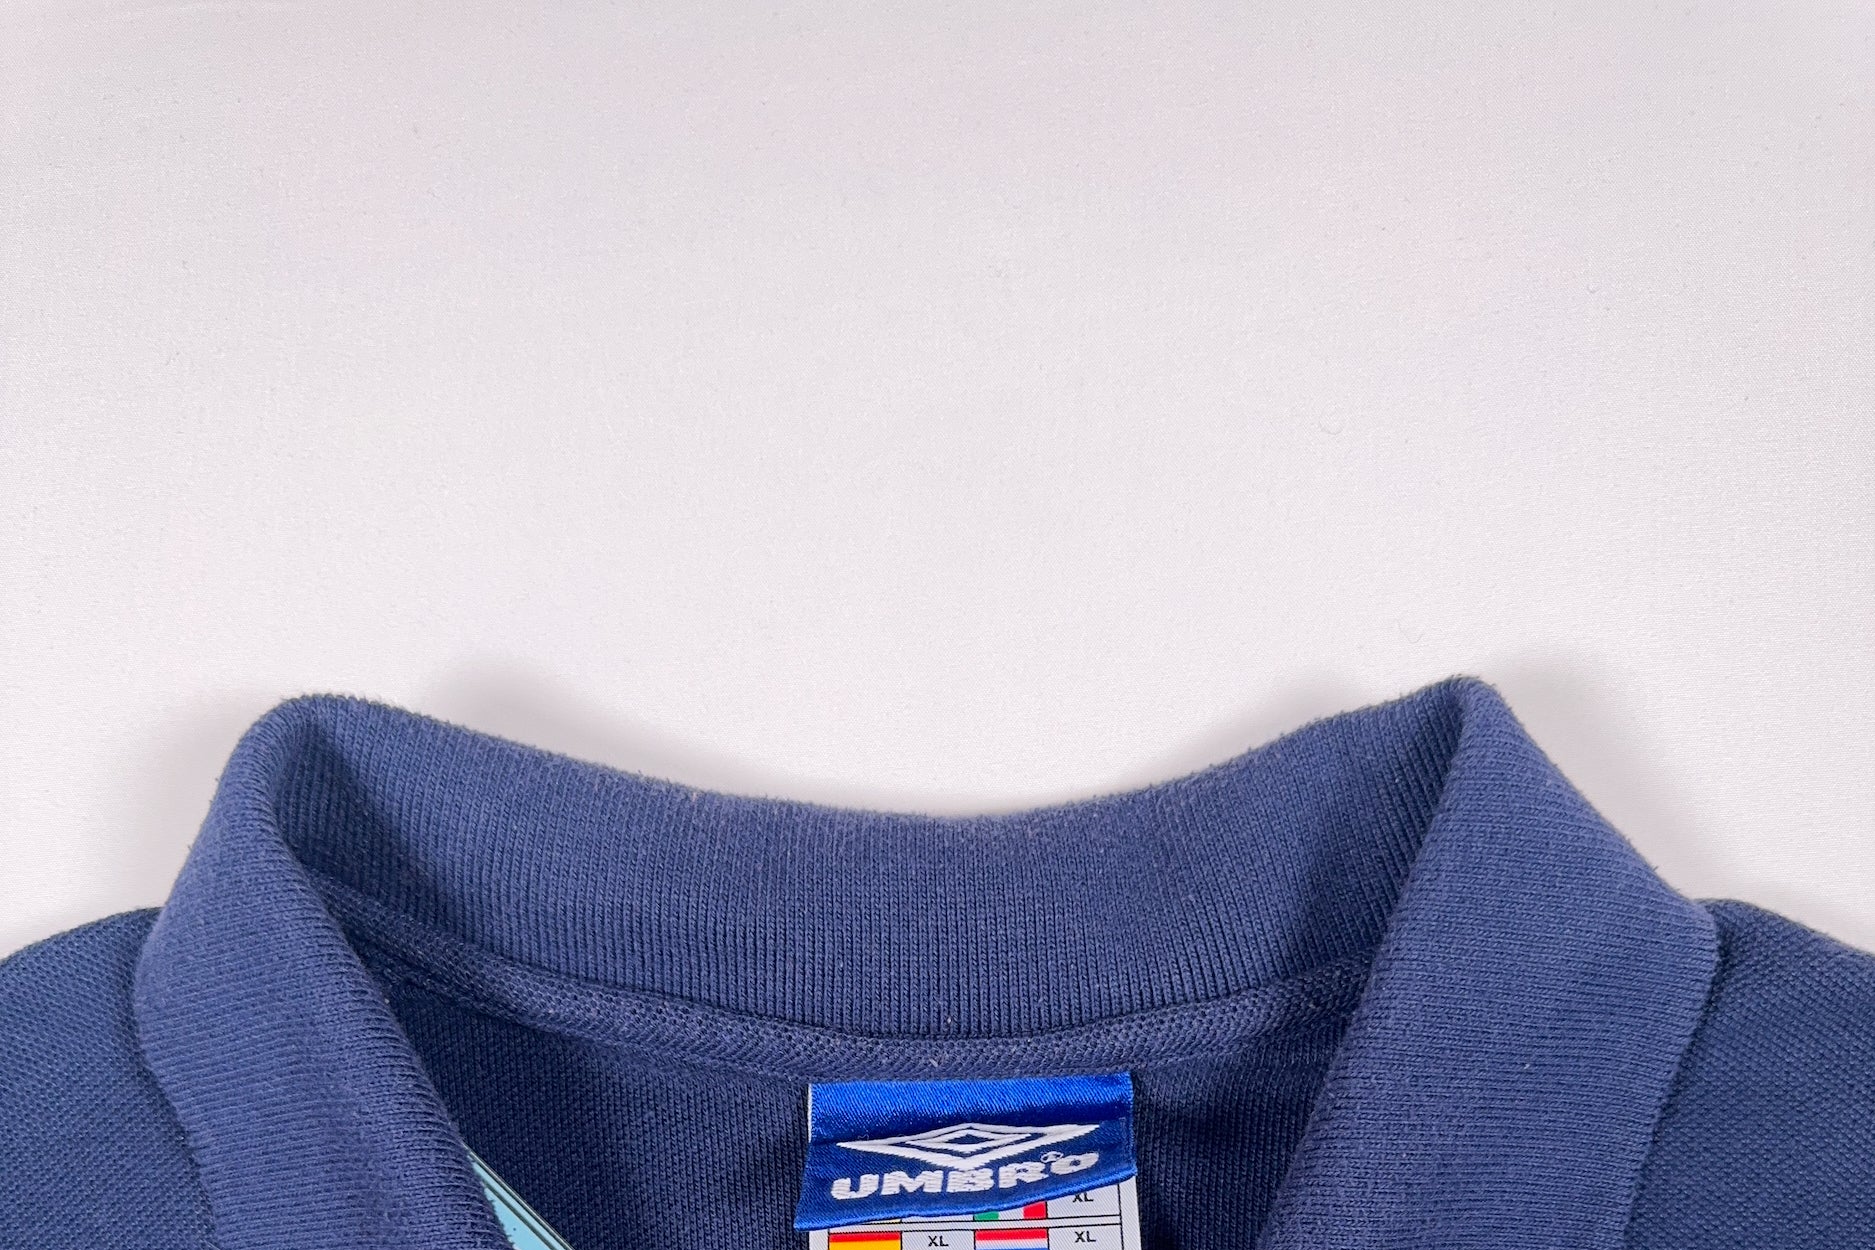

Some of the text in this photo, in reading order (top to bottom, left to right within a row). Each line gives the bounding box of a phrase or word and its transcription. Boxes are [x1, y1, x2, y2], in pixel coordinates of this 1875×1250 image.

[830, 1152, 1100, 1200] UMBRO
[928, 1235, 949, 1247] XL
[1075, 1231, 1097, 1243] XL
